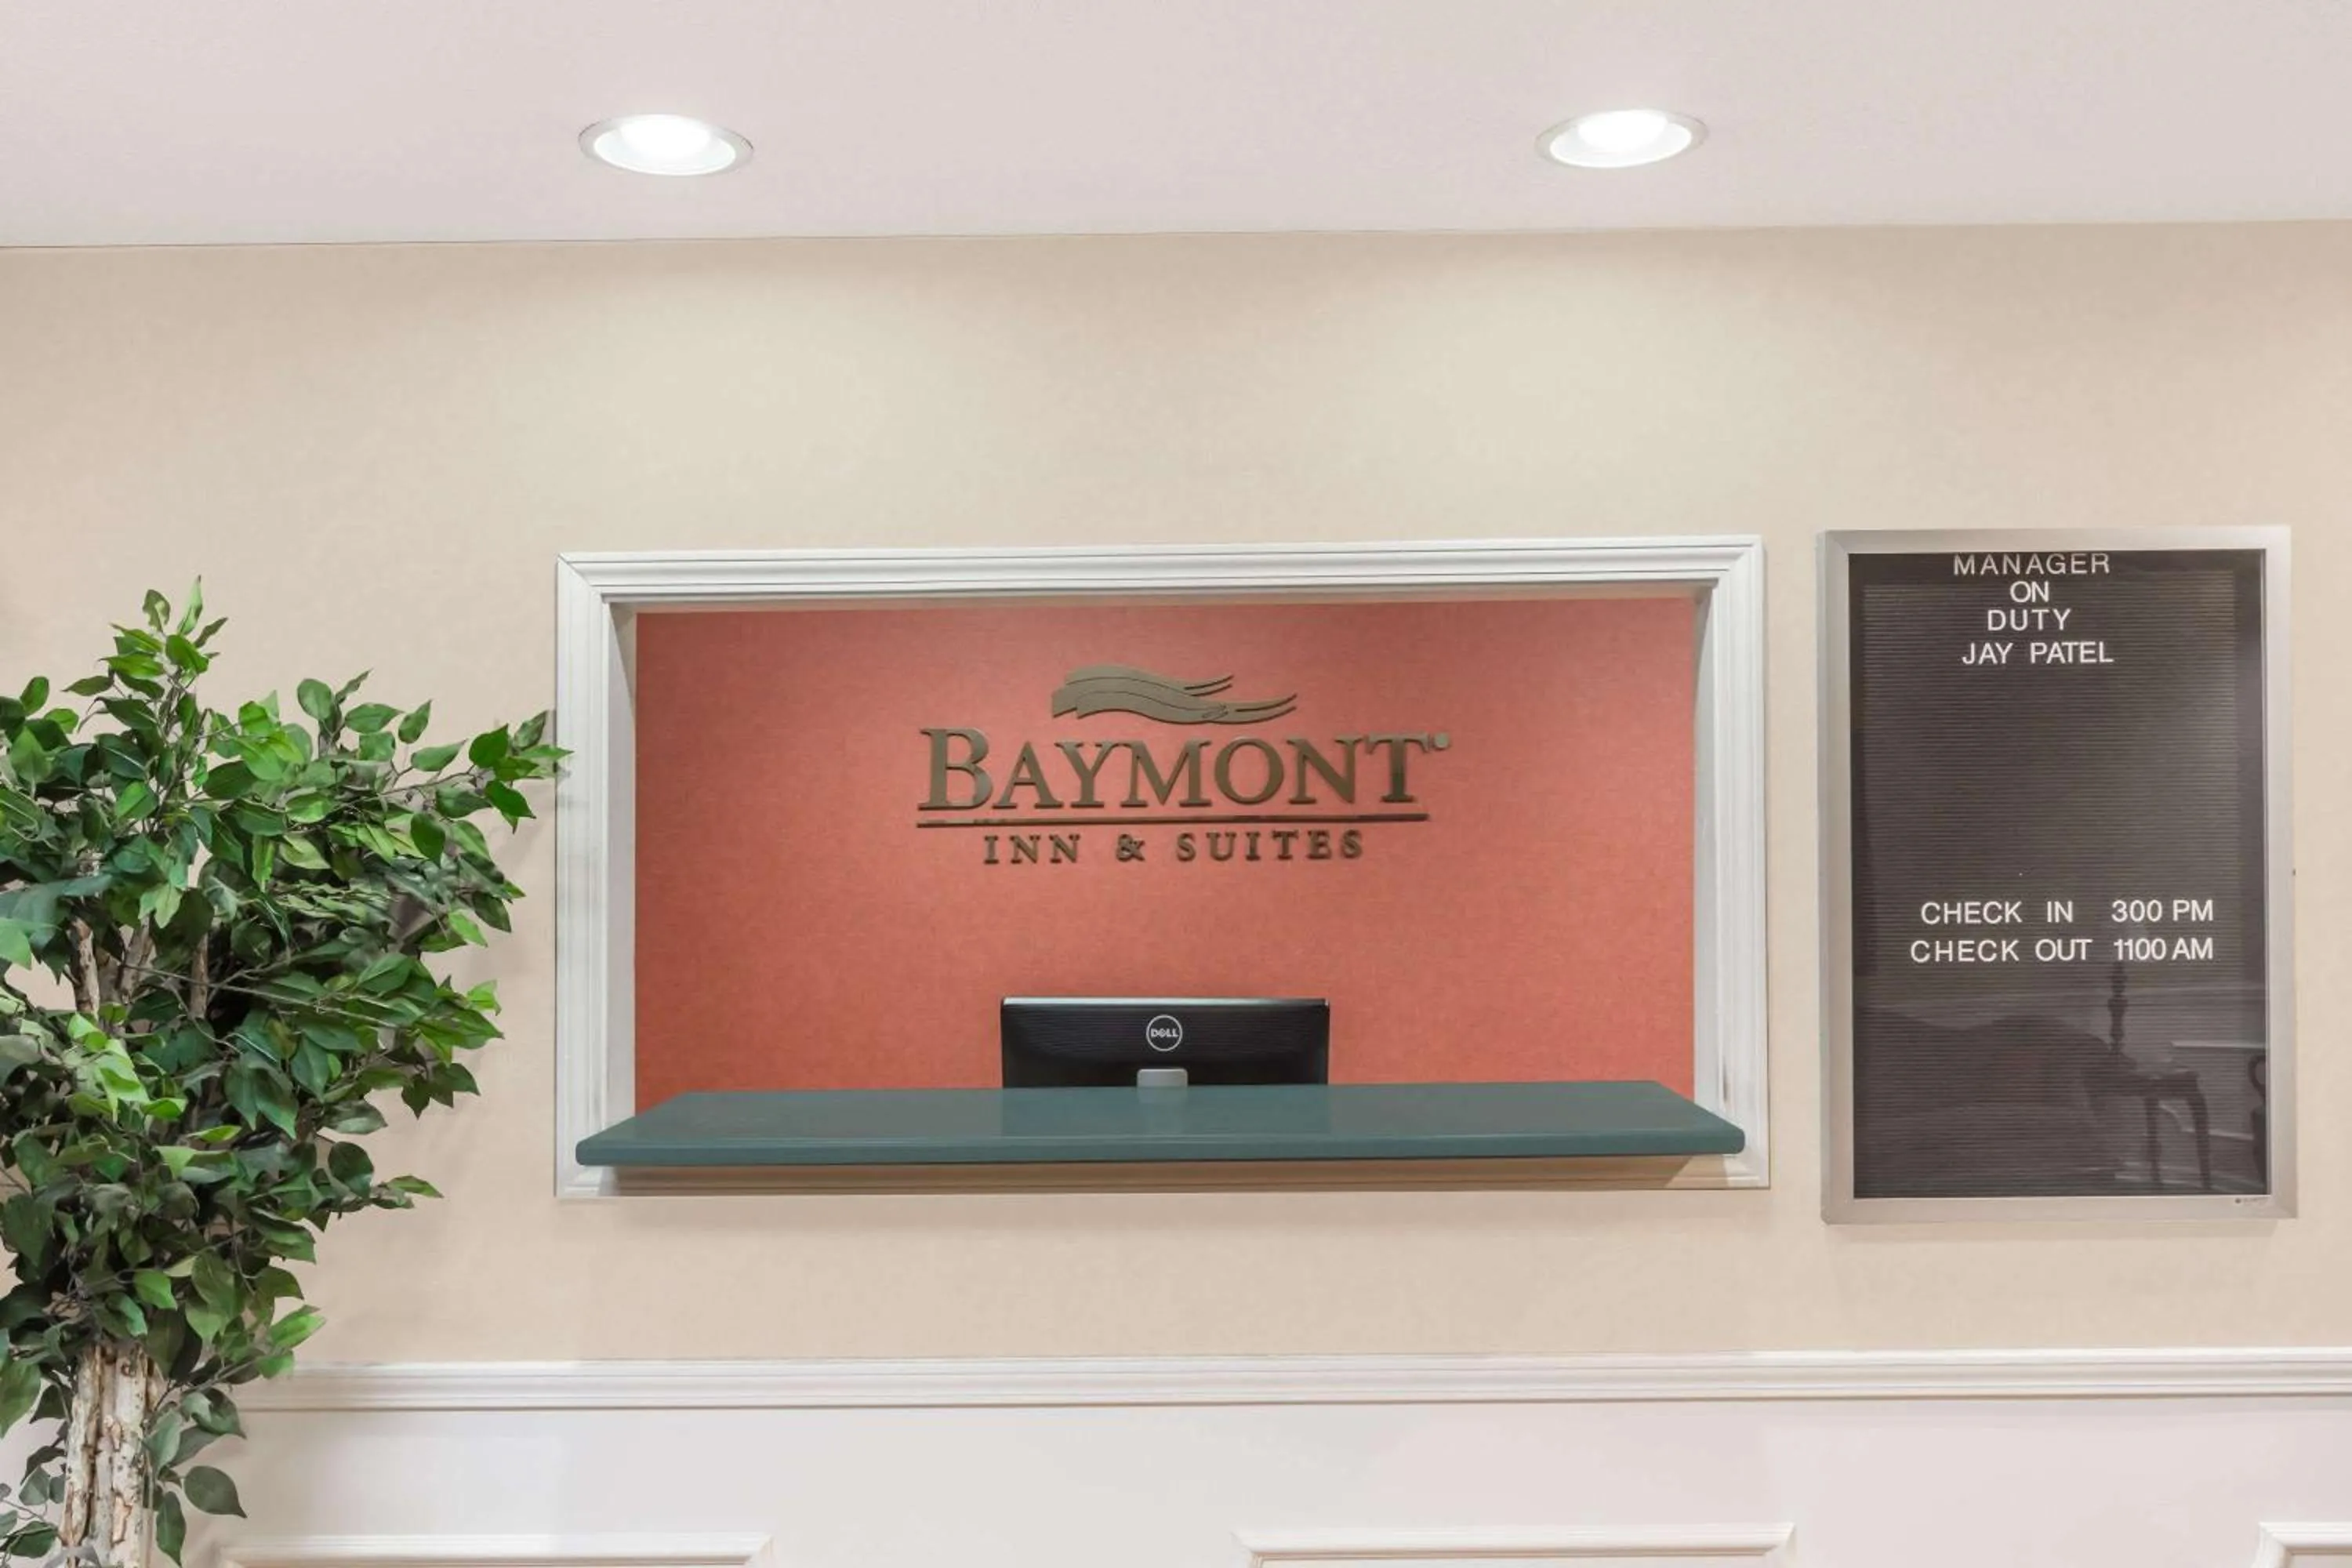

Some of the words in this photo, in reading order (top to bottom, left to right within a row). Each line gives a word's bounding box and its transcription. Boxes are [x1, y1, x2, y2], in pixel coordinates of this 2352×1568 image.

[1954, 553, 2111, 575] MANAGER
[2009, 581, 2049, 603] ON
[1987, 608, 2071, 631] DUTY
[1962, 643, 2013, 665] JAY
[2030, 641, 2114, 664] PATEL
[917, 728, 1431, 811] BAYMONT
[984, 834, 1080, 864] INN
[1116, 833, 1145, 861] &
[1177, 829, 1363, 861] SUITES
[1920, 901, 2023, 924] CHECK
[2046, 901, 2074, 923] IN
[2111, 899, 2163, 923] 300
[2172, 899, 2214, 921] PM
[1910, 940, 2020, 963] CHECK
[2034, 939, 2093, 962] OUT
[2113, 939, 2166, 961] 1100
[2172, 938, 2214, 960] AM
[1150, 1028, 1178, 1037] DELL
